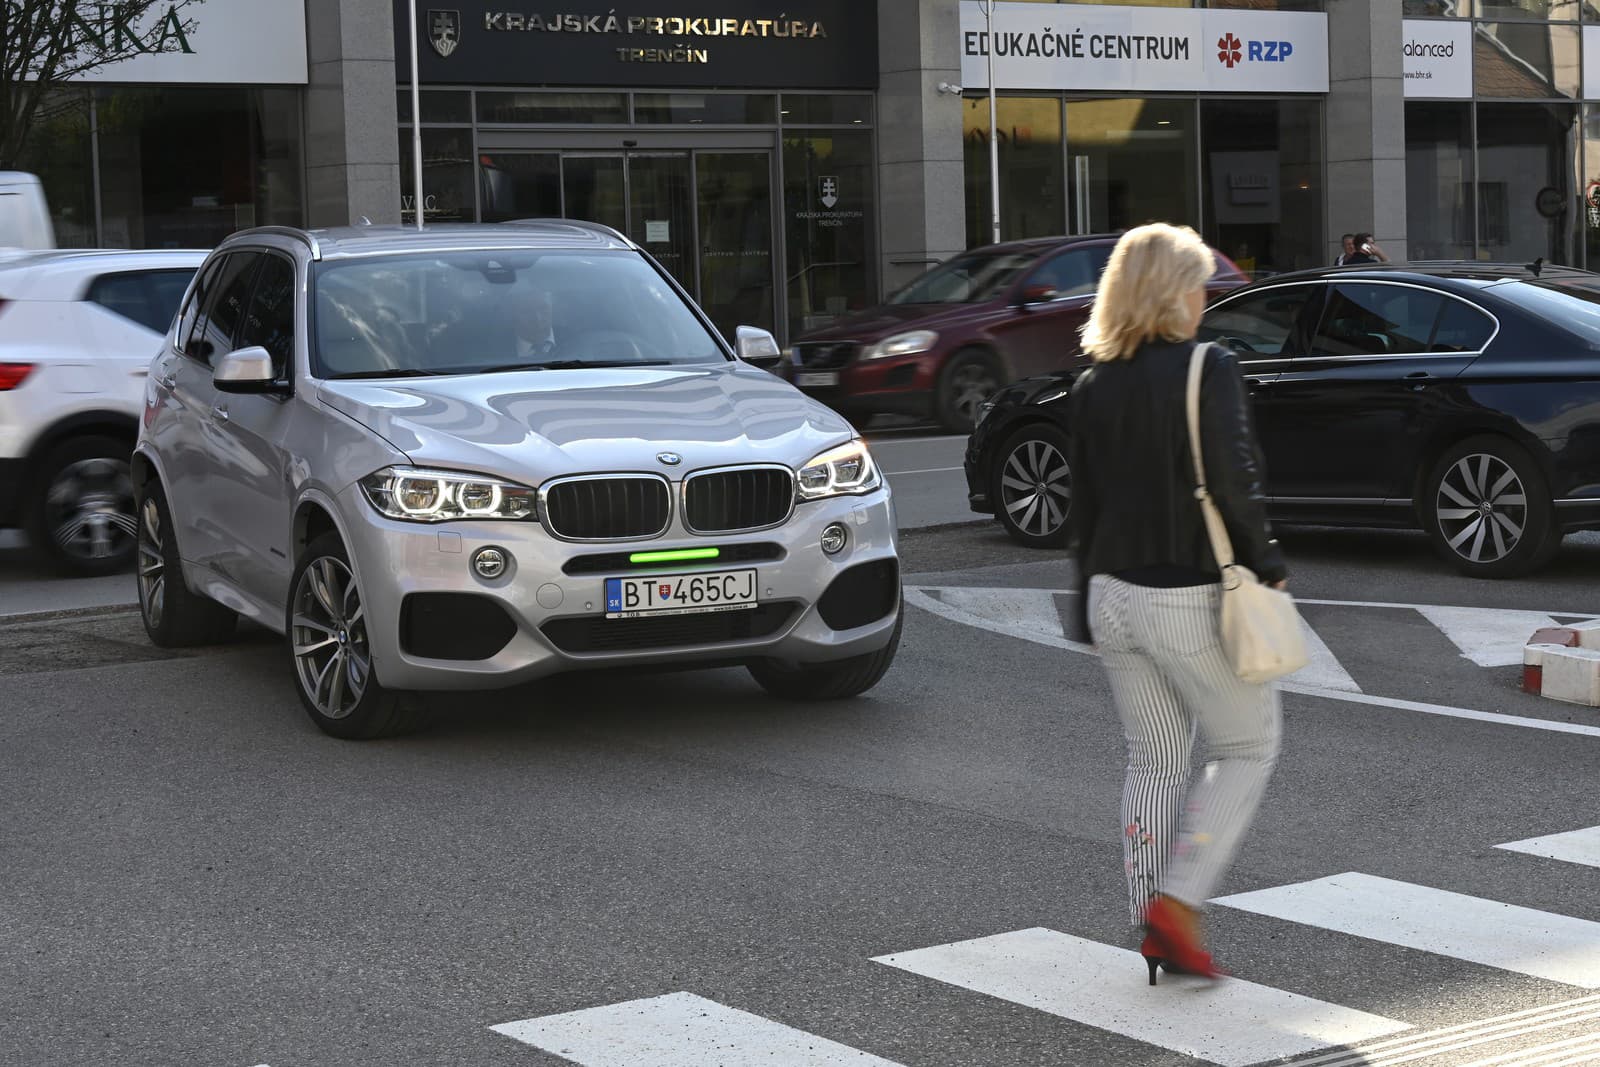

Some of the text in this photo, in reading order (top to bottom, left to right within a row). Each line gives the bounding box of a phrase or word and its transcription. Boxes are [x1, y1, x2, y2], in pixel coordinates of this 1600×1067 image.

[485, 8, 827, 38] KRAJSKÁ PROKURATÚRA
[616, 43, 708, 63] TRENČÍN
[964, 27, 1190, 61] EDUKAČNÉ CENTRUM
[1248, 40, 1293, 62] RZP
[1402, 40, 1454, 57] alanced
[1402, 70, 1433, 80] ww.bhr.sk
[624, 573, 753, 608] BT 465CJ
[608, 599, 621, 608] SK
